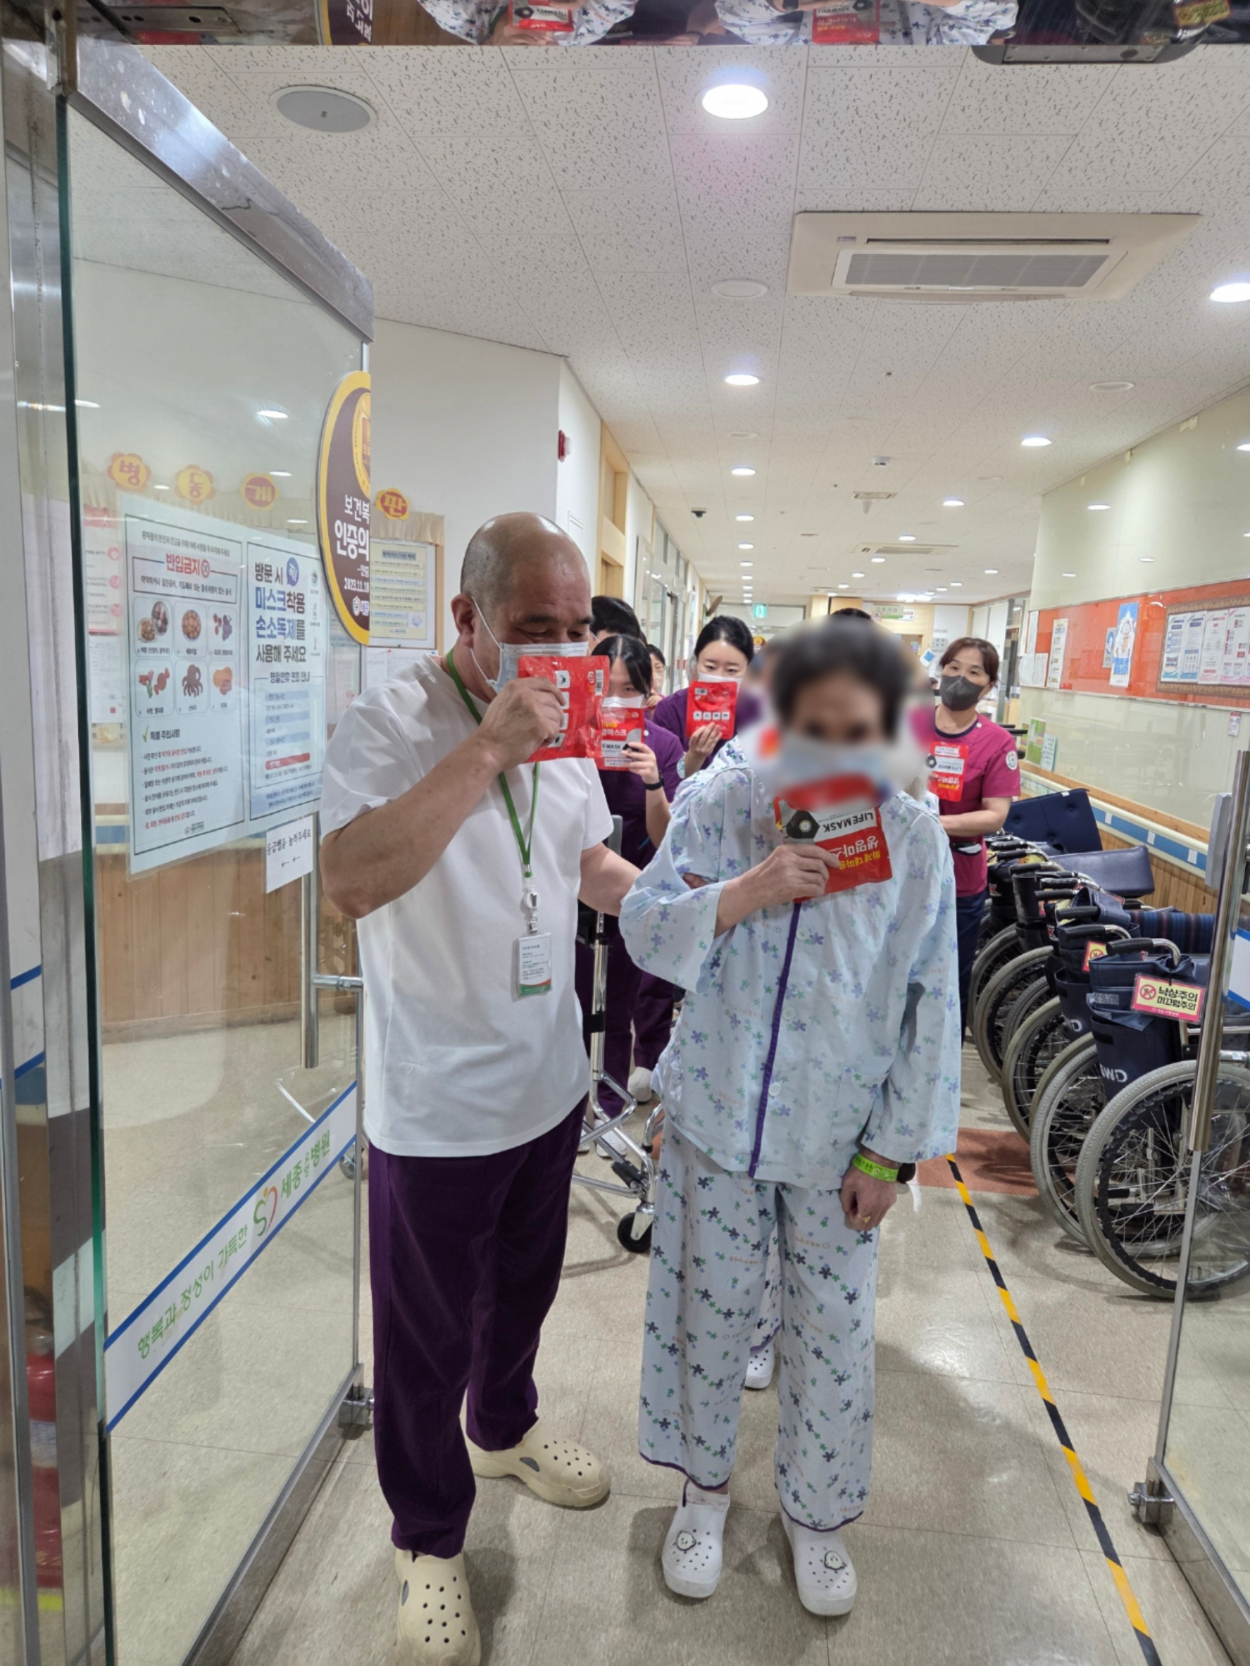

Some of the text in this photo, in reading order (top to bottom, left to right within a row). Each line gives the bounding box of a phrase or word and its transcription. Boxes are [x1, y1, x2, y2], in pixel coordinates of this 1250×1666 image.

[119, 459, 141, 486] 병
[188, 473, 202, 499] 동
[384, 494, 408, 516] 판
[334, 520, 370, 562] 인증의
[166, 552, 200, 576] 반입금지
[254, 562, 272, 584] 방문
[274, 566, 282, 585] 시
[255, 586, 305, 614] 마스크착용
[256, 615, 305, 640] 손소독제를
[256, 644, 306, 663] 사용해 주세요
[829, 836, 878, 858] 생명마스
[839, 851, 880, 870] 화재 대피용
[1156, 996, 1196, 1011] 미끄럼주의
[1158, 986, 1198, 1002] 낙상주의
[138, 1303, 176, 1360] 행복과
[180, 1260, 214, 1312] 정성이
[218, 1224, 248, 1268] 가득한
